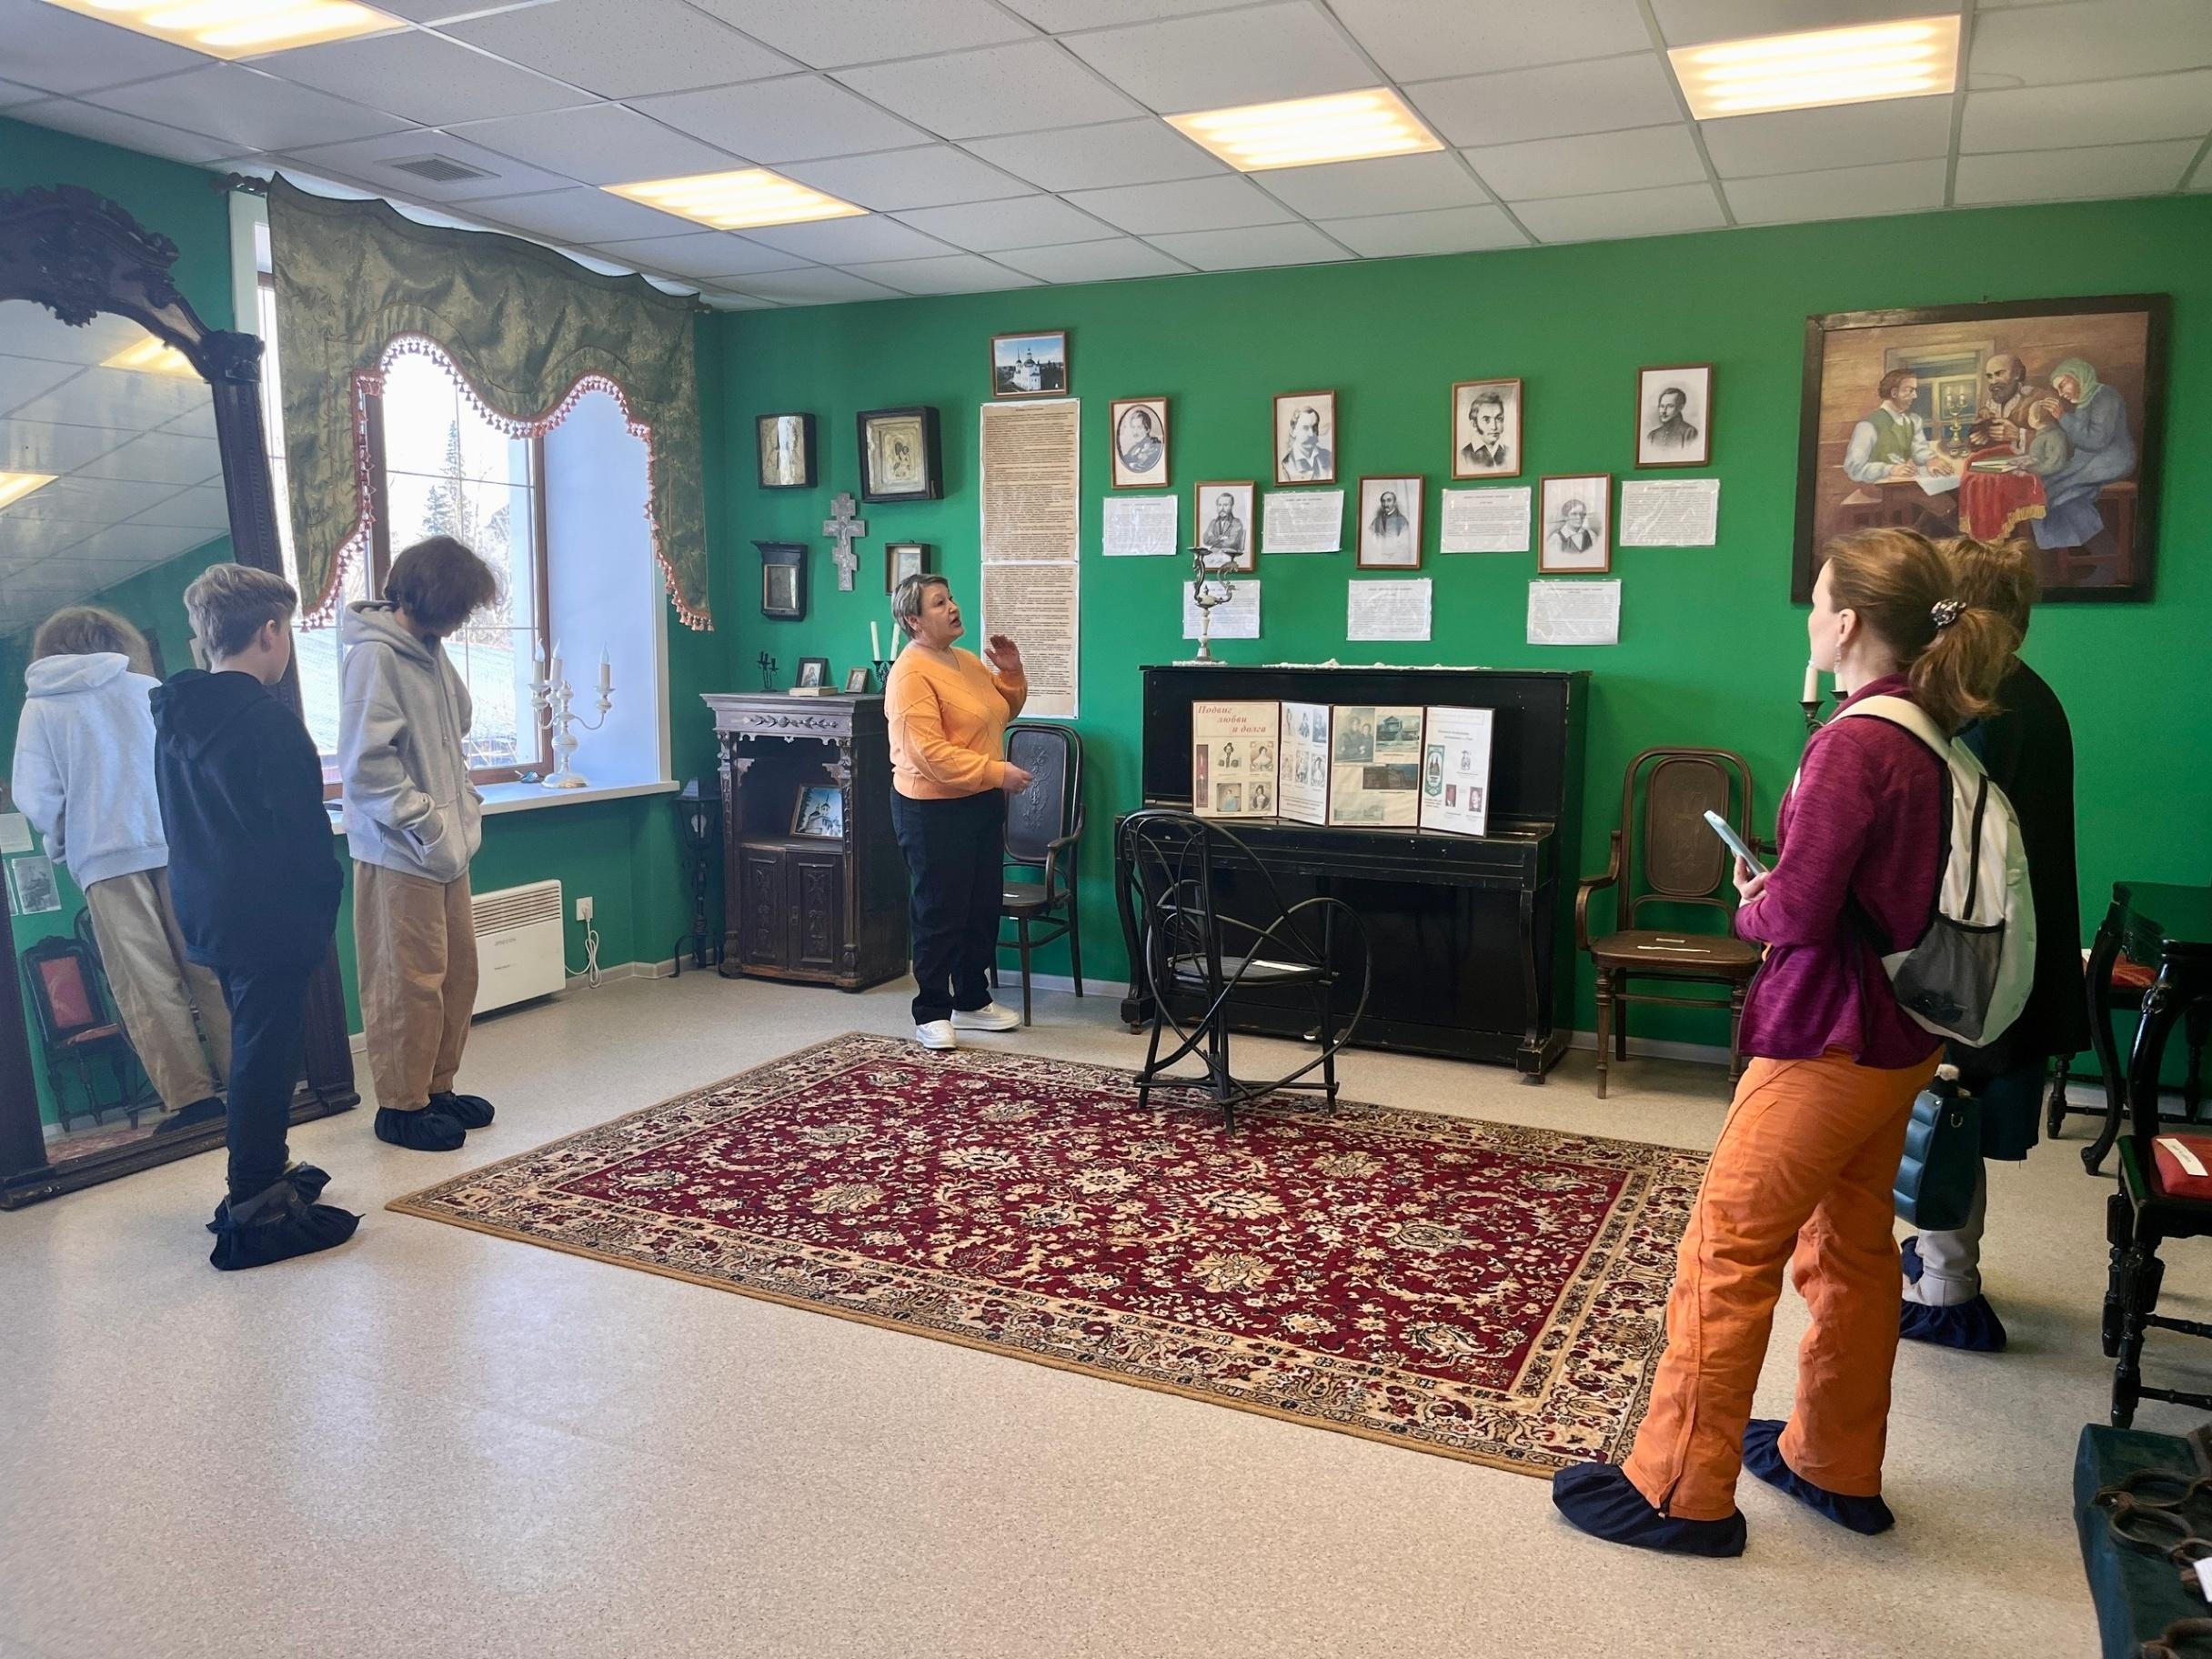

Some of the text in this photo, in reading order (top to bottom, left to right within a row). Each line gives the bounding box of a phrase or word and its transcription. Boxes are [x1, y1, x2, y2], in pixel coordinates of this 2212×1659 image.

[1198, 705, 1233, 714] Подвиг
[1217, 715, 1247, 724] любви
[1241, 725, 1266, 733] долга
